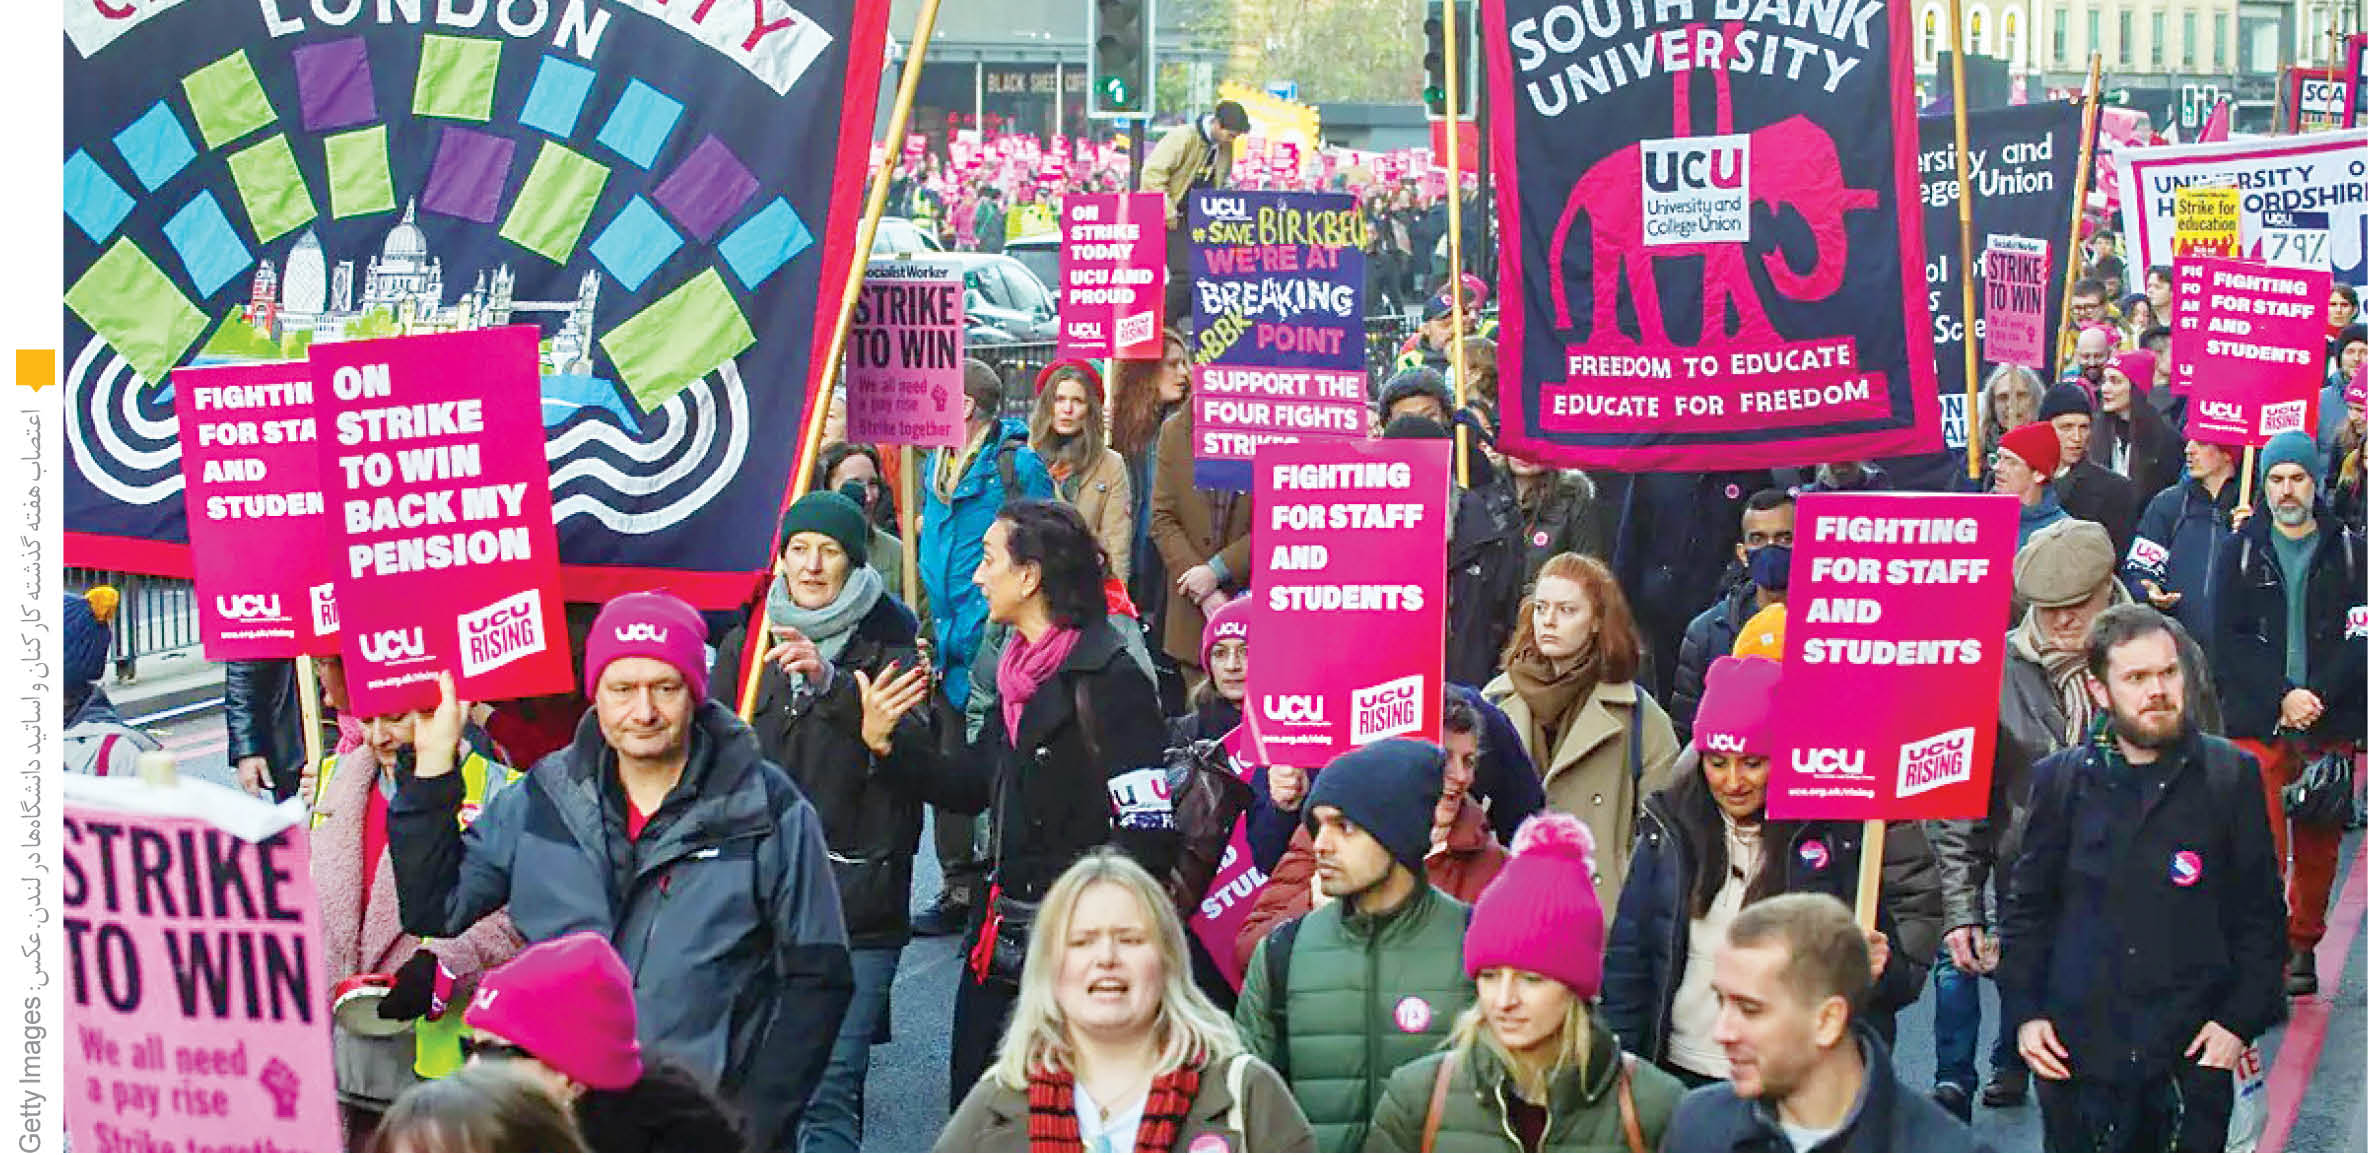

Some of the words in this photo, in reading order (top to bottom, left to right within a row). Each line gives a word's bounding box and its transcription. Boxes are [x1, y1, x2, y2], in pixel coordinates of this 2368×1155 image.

[1527, 28, 1860, 116] UNIVERSITY
[2002, 132, 2053, 164] and
[1645, 148, 1743, 192] UCU
[1979, 166, 2053, 197] Union
[1071, 204, 1099, 221] ON
[1201, 197, 1245, 216] UCU
[1648, 198, 1712, 216] University
[1714, 196, 1741, 212] and
[2179, 199, 2215, 216] Strike
[2219, 200, 2236, 216] for
[1070, 224, 1140, 241] STRIKE
[1648, 219, 1698, 238] College
[1699, 215, 1742, 232] Union
[2178, 214, 2237, 232] education
[1069, 244, 1134, 260] TODAY
[1204, 244, 1298, 276] WE'RE
[1306, 244, 1342, 269] AT
[1069, 269, 1109, 285] UCU
[1109, 269, 1155, 285] AND
[1989, 253, 2041, 285] STRIKE
[1069, 289, 1136, 304] PROUD
[2213, 271, 2308, 296] FIGHTING
[854, 284, 955, 326] STRIKE
[1197, 278, 1355, 318] BREAKING
[1989, 282, 2006, 311] TO
[2010, 285, 2041, 314] WIN
[2211, 294, 2251, 313] FOR
[2252, 299, 2316, 320] STAFF
[1068, 323, 1101, 337] UCU
[1257, 322, 1346, 355] POINT
[2208, 317, 2251, 335] AND
[853, 328, 891, 369] TO
[899, 328, 957, 369] WIN
[1568, 355, 1672, 379] FREEDOM
[1683, 358, 1719, 377] TO
[1730, 344, 1850, 375] EDUCATE
[2206, 339, 2312, 365] STUDENTS
[194, 381, 314, 411] FIGHTIN
[333, 364, 390, 401] ON
[1203, 370, 1310, 394] SUPPORT
[1314, 375, 1360, 398] THE
[1553, 394, 1659, 418] EDUCATE
[1675, 396, 1724, 416] FOR
[1740, 379, 1870, 413] FREEDOM
[2200, 400, 2243, 419] UCU
[336, 399, 484, 446] STRIKE
[1203, 401, 1270, 425] FOUR
[1274, 405, 1358, 430] FIGHTS
[198, 422, 259, 447] FOR
[262, 418, 317, 444] STA
[203, 458, 267, 484] AND
[339, 452, 393, 489] TO
[399, 444, 481, 483] WIN
[1273, 463, 1411, 490] FIGHTING
[207, 491, 325, 520] STUDEN
[345, 491, 457, 535] BACK
[463, 483, 528, 522] MY
[1272, 504, 1326, 530] FOR
[1327, 503, 1425, 530] STAFF
[1815, 516, 1978, 545] FIGHTING
[349, 527, 531, 579] PENSION
[1270, 545, 1328, 571] AND
[1811, 558, 1881, 584] FOR
[1885, 559, 1990, 585] STAFF
[216, 593, 281, 619] UCU
[1269, 584, 1425, 611] STUDENTS
[468, 602, 530, 633] UCU
[1806, 600, 1882, 624] AND
[471, 617, 536, 665] RISING
[615, 622, 668, 643] UCU
[1214, 621, 1247, 637] UCU
[359, 626, 425, 663] UCU
[1803, 639, 1983, 666] STUDENTS
[1263, 695, 1324, 721] UCU
[1359, 685, 1415, 708] UCU
[1359, 699, 1415, 736] RISING
[1706, 732, 1747, 753] UCU
[1908, 736, 1965, 762] UCU
[1791, 748, 1866, 774] UCU
[1904, 749, 1963, 788] RISING
[63, 817, 303, 922] STRIKE
[63, 919, 143, 1014] TO
[163, 928, 314, 1024] WIN
[79, 1024, 121, 1068] We
[131, 1033, 165, 1071] all
[176, 1040, 248, 1077] need
[86, 1076, 102, 1104] a
[112, 1080, 160, 1119] pay
[171, 1079, 229, 1118] rise
